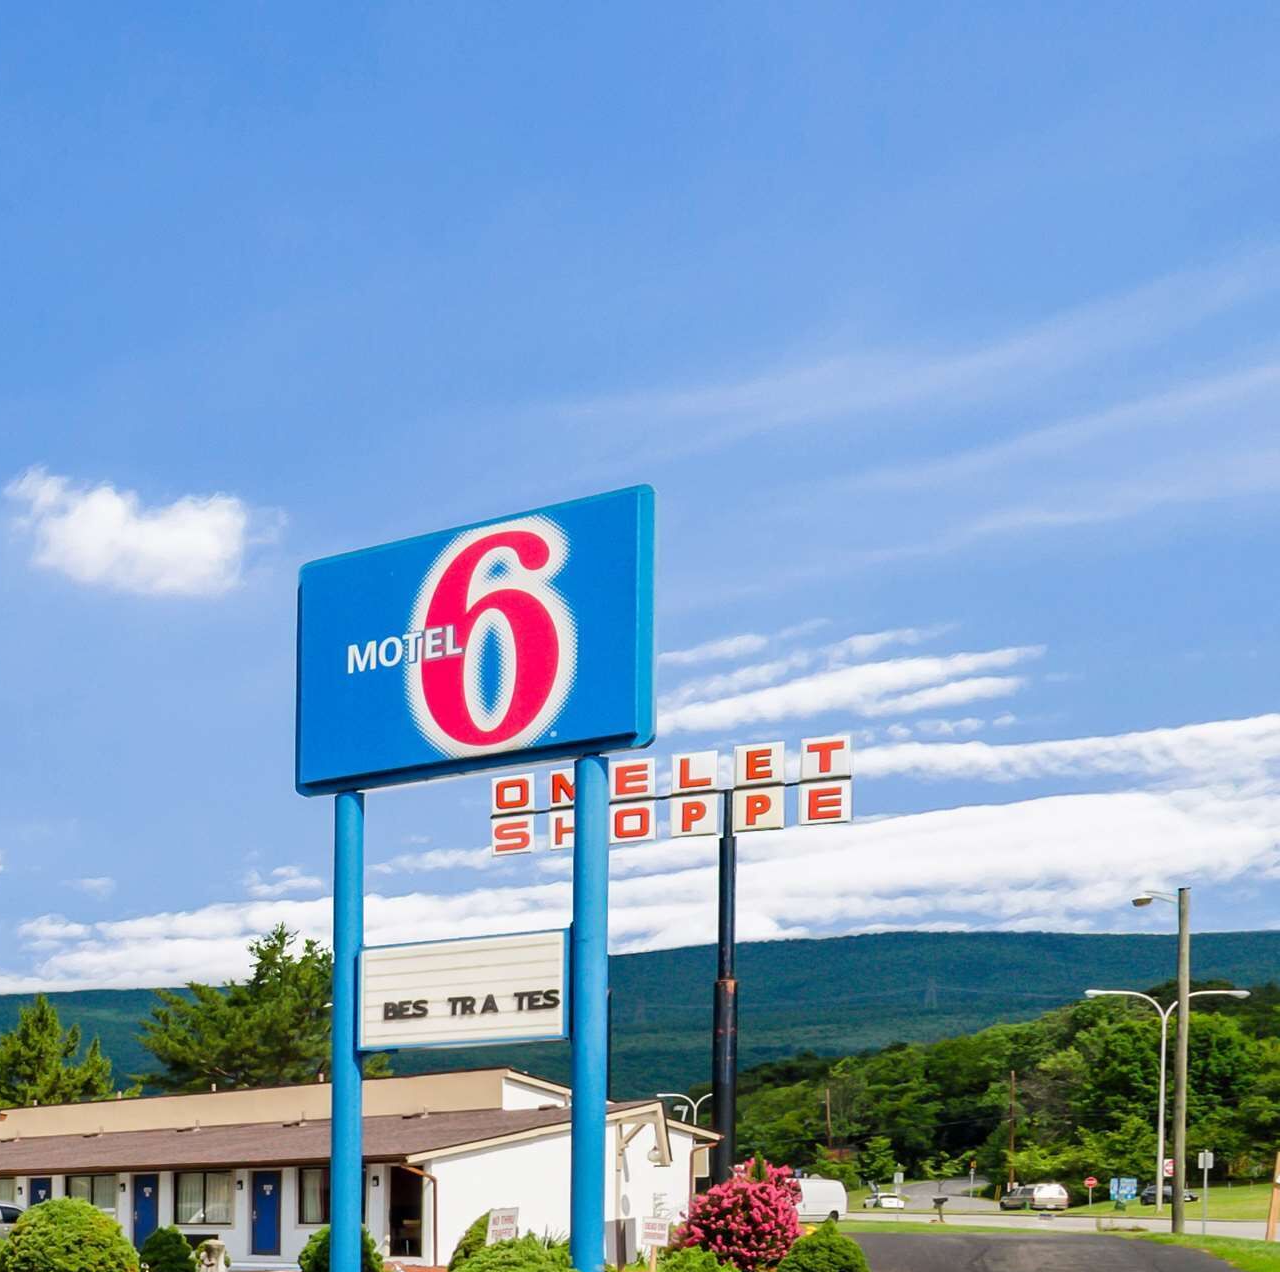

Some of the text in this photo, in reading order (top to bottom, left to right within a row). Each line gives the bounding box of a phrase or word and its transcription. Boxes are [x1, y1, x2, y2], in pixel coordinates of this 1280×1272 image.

[346, 528, 562, 748] MOTEL 6
[495, 740, 845, 810] OMELET
[494, 787, 842, 851] SHOPPE
[383, 999, 429, 1021] BES
[514, 989, 561, 1011] TES
